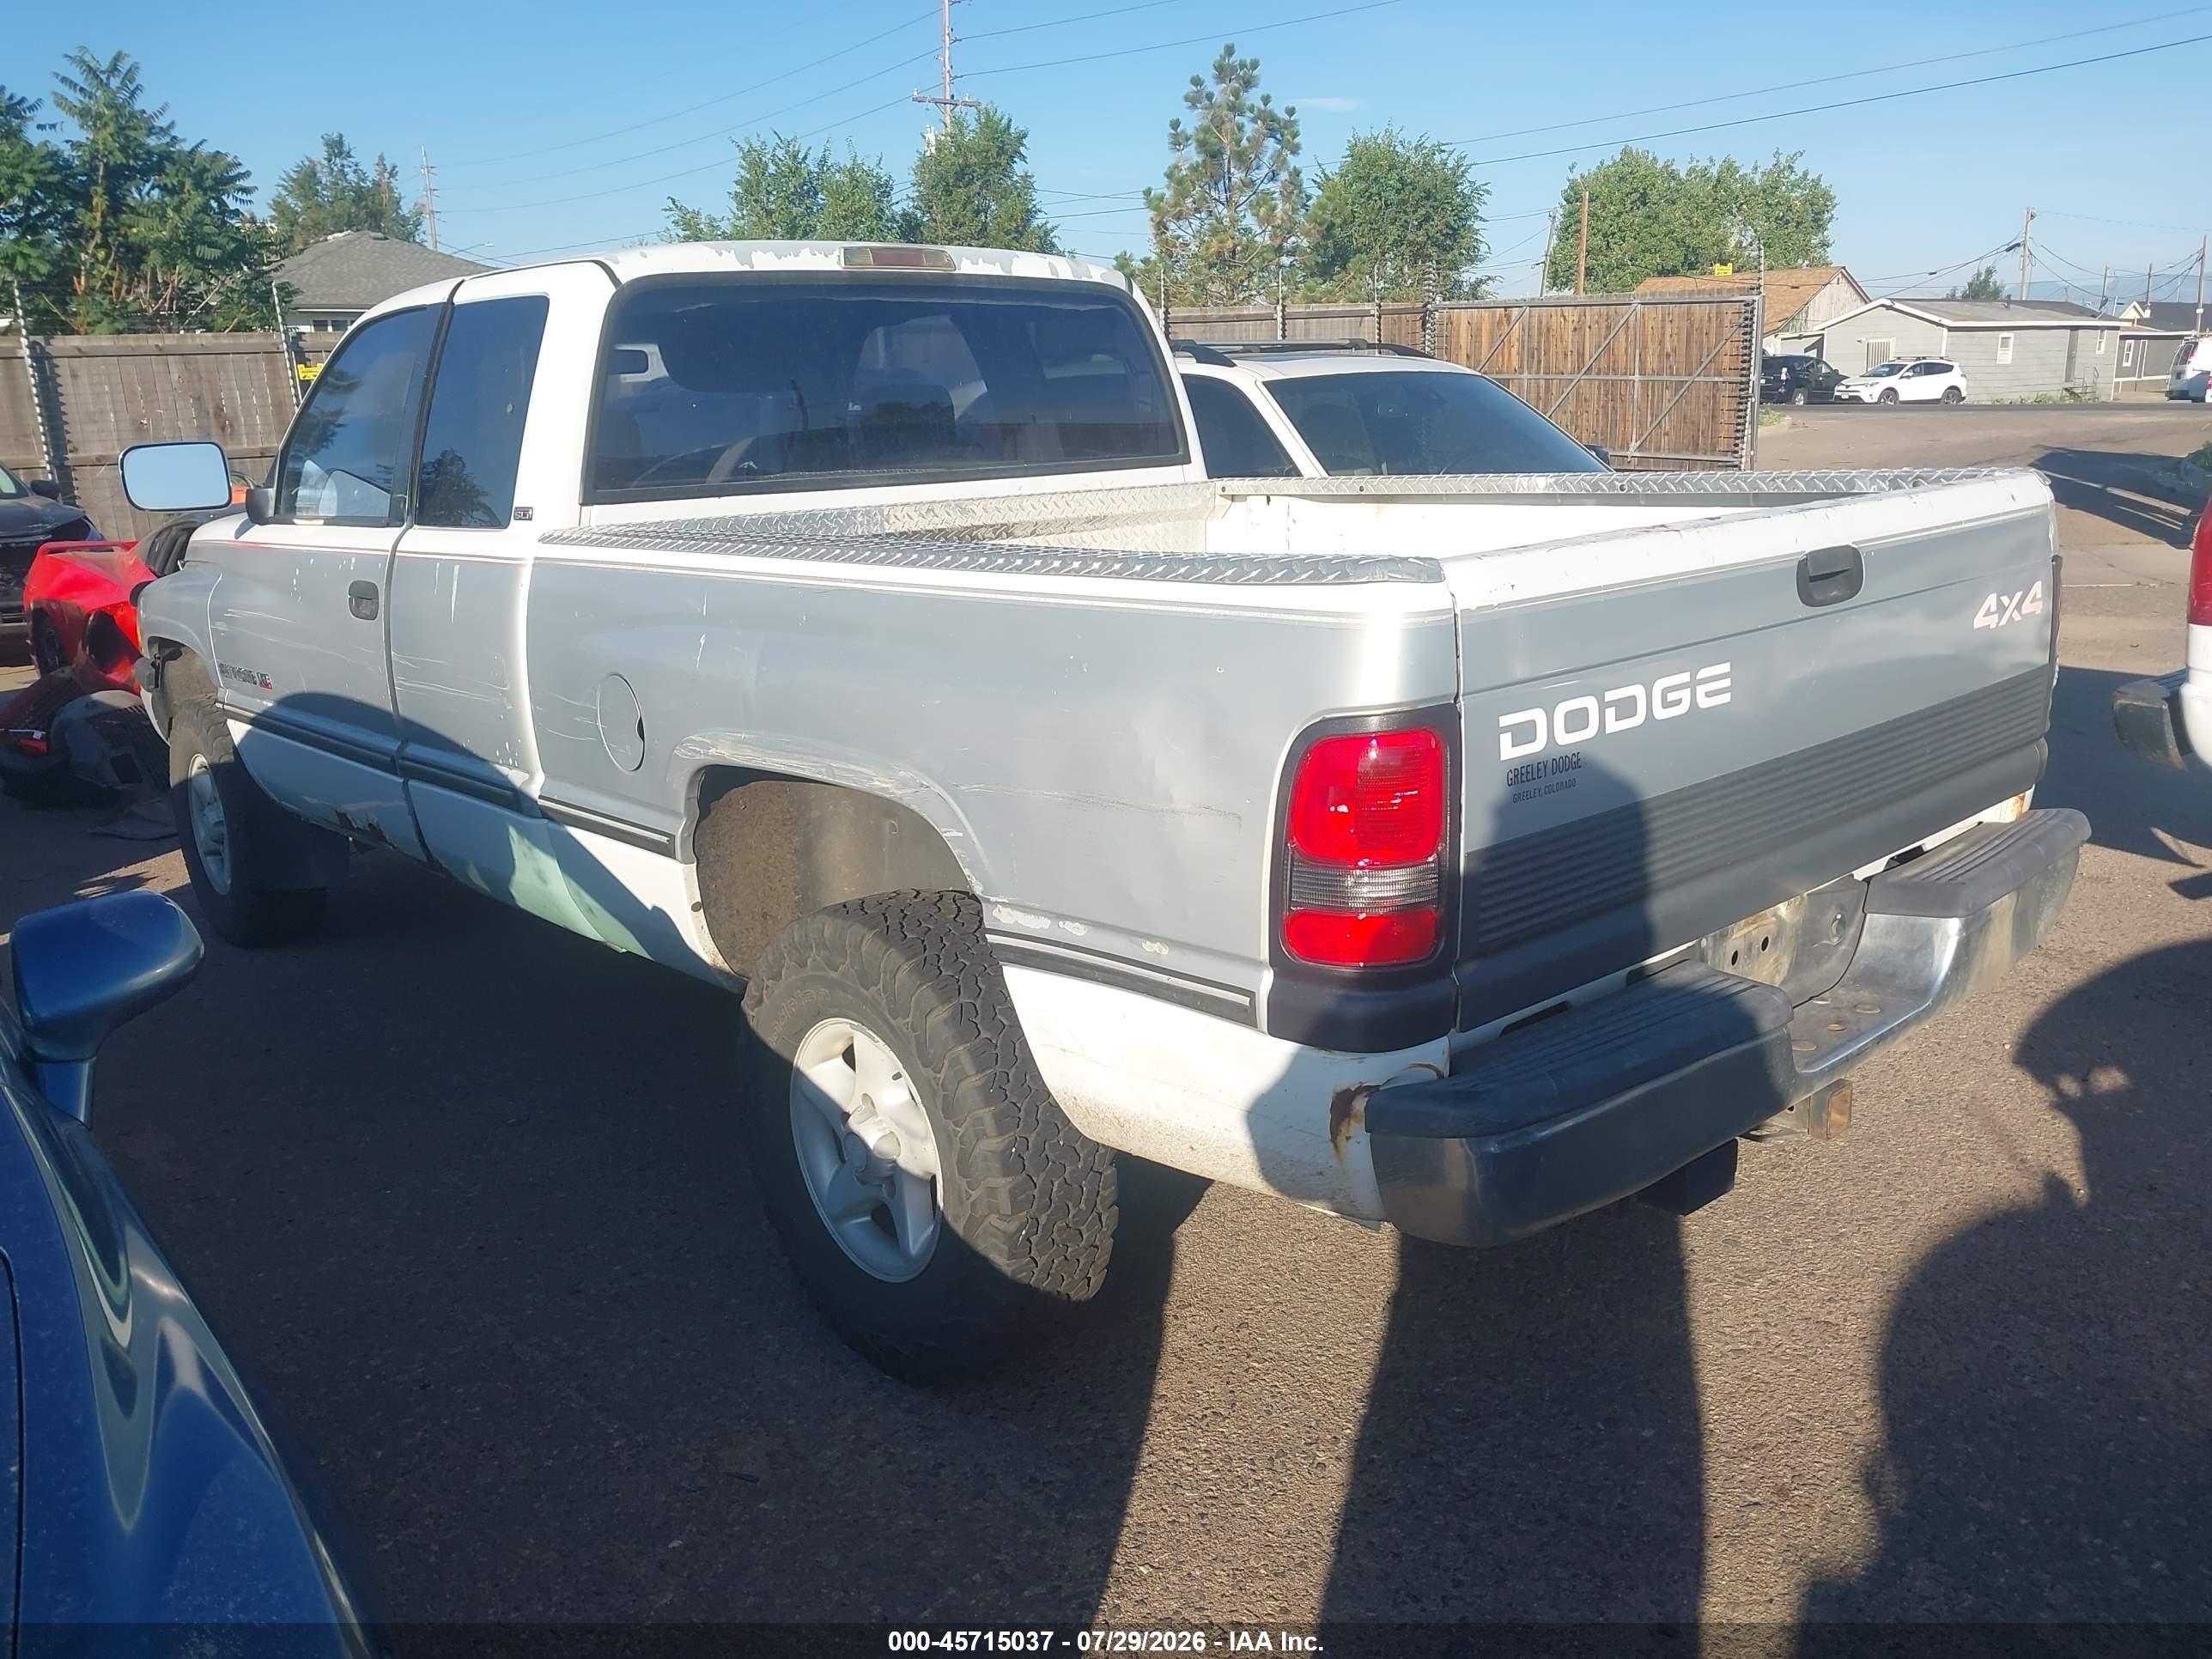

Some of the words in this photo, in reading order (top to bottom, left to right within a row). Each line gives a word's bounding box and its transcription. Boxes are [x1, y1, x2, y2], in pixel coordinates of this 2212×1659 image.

[1498, 660, 1732, 762] DODGE
[1506, 759, 1548, 787] GREELEY
[1551, 751, 1582, 775] DODGE
[1544, 777, 1577, 795] COLORADO
